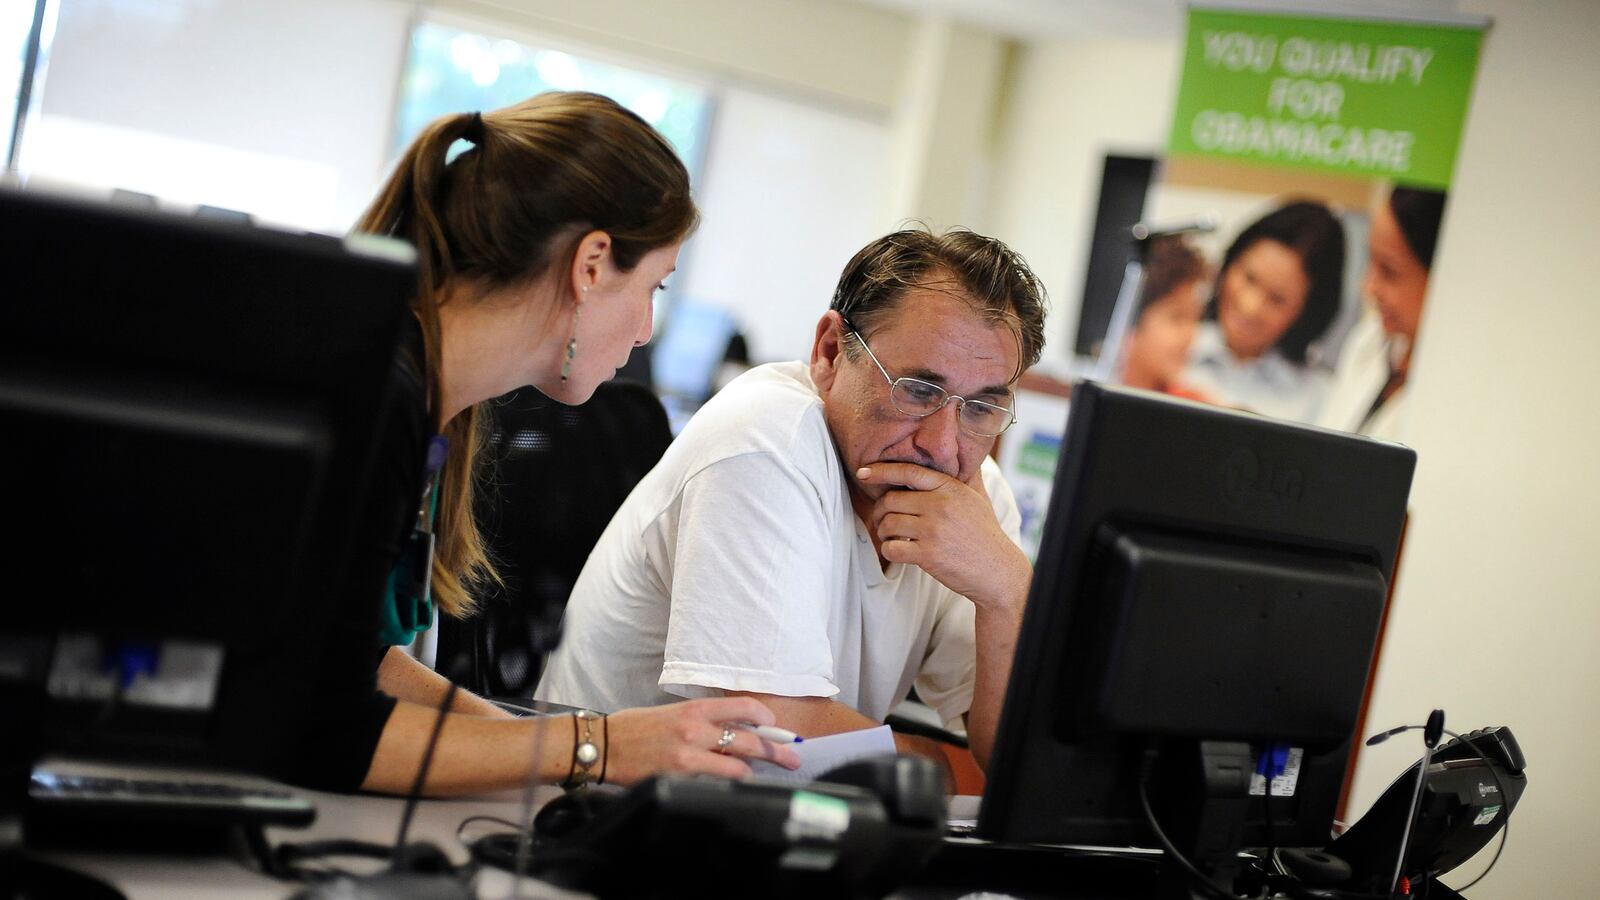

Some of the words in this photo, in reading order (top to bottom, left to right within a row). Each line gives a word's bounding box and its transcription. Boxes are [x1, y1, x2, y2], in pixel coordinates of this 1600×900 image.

[1204, 31, 1277, 72] YOU
[1280, 37, 1432, 85] QUALIFY
[1268, 78, 1345, 120] FOR
[1191, 110, 1413, 171] OBAMACARE
